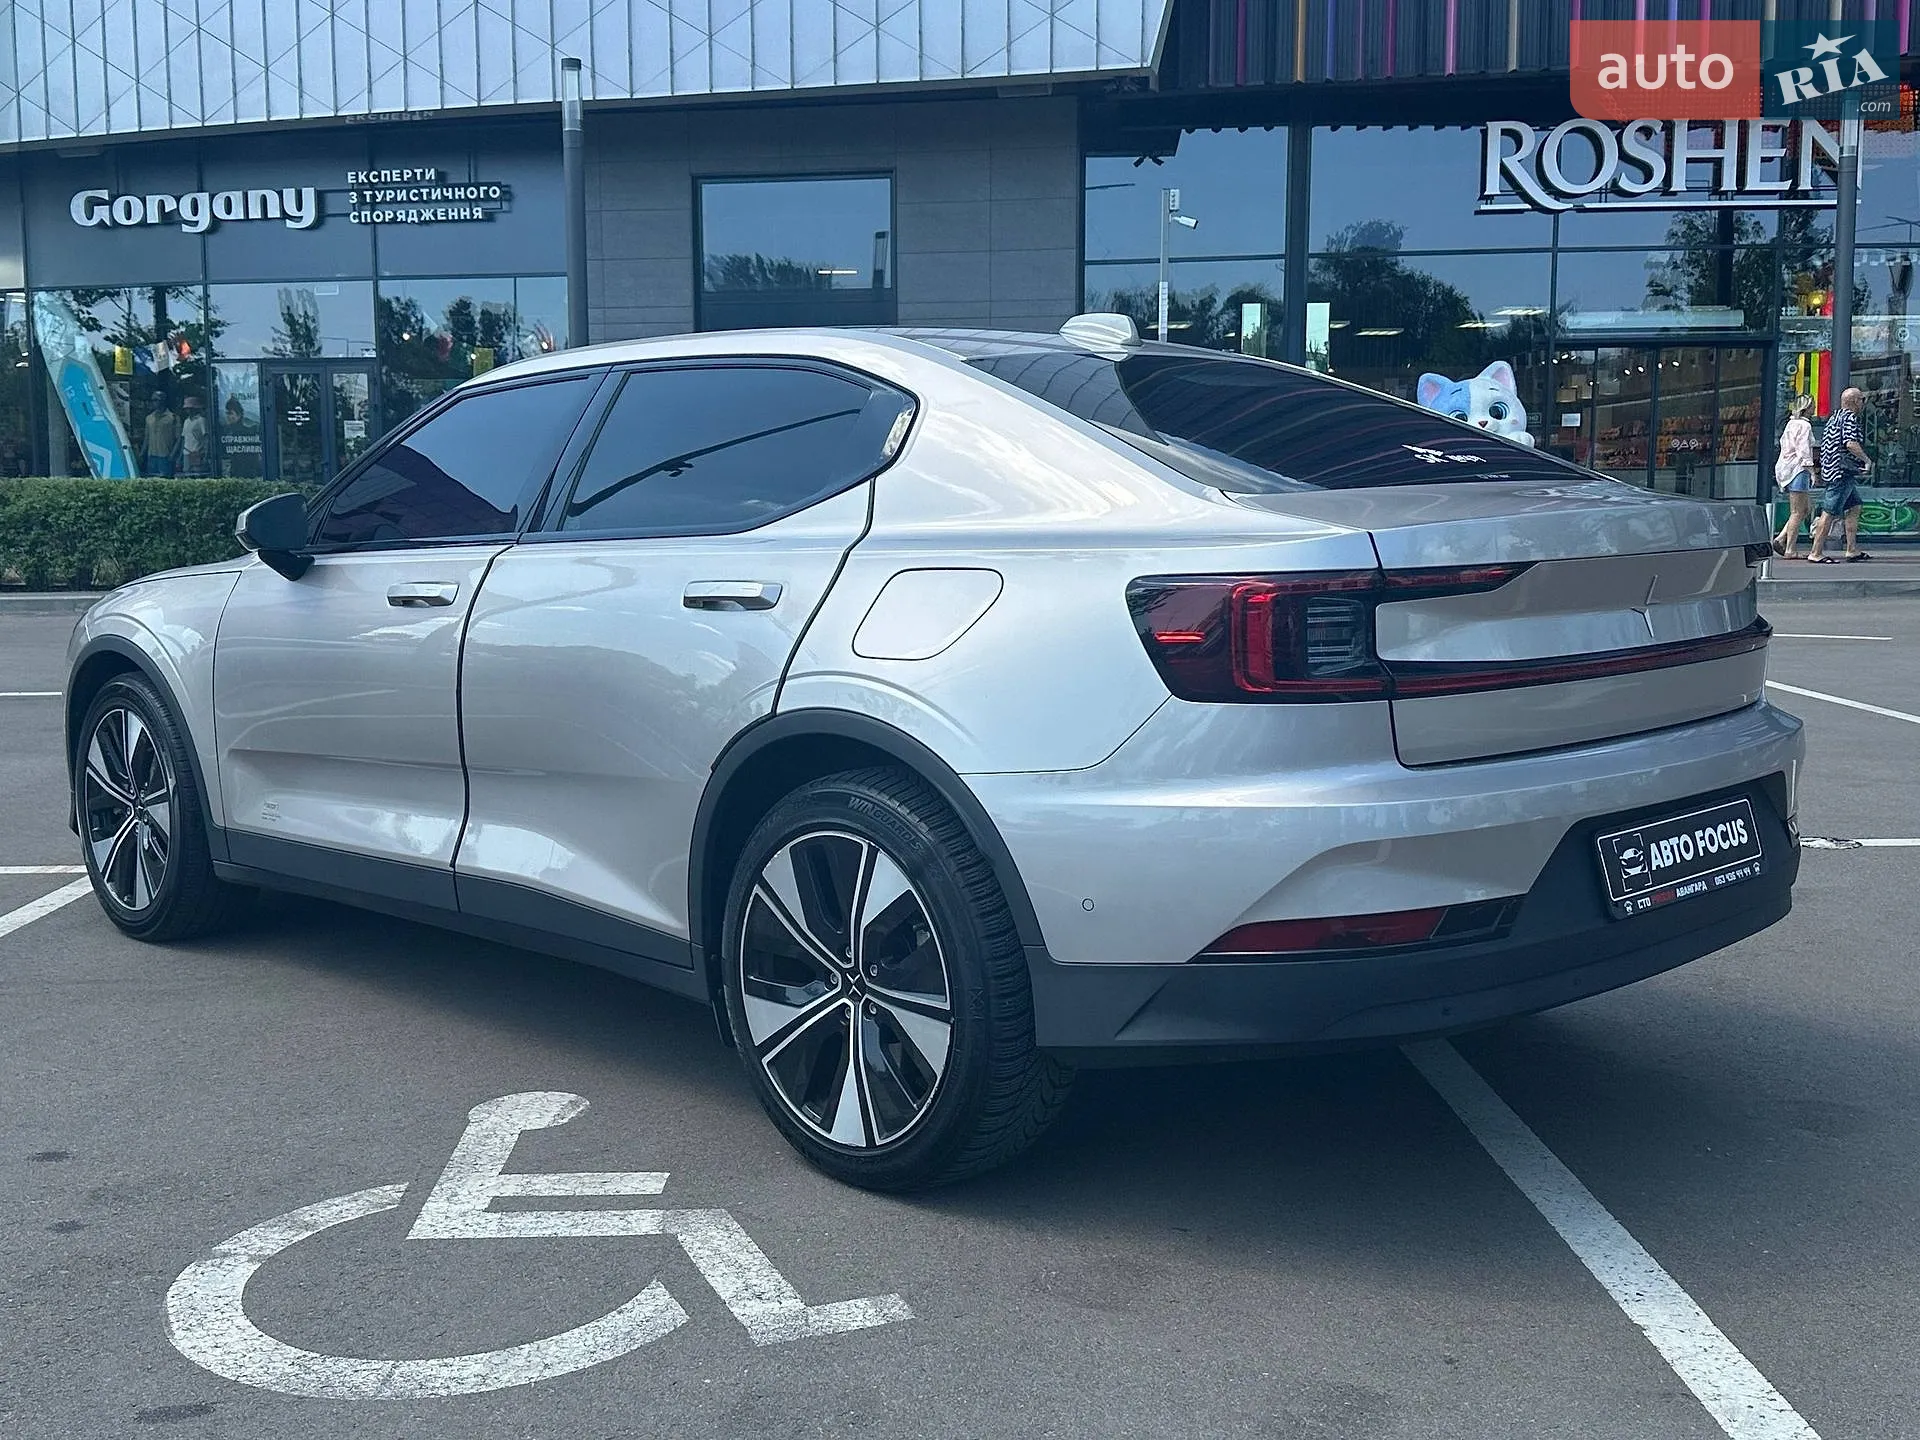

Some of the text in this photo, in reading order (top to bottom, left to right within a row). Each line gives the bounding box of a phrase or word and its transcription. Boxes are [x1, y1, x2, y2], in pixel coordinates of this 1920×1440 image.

[347, 168, 436, 184] ЕКСПЕРТИ
[1483, 118, 1862, 210] ROSHEN
[363, 186, 501, 203] ТУРИСТИЧНОГО
[70, 186, 316, 234] Gorgany
[349, 207, 483, 224] СПОРЯДЖЕННЯ
[1695, 818, 1748, 857] FOCUS
